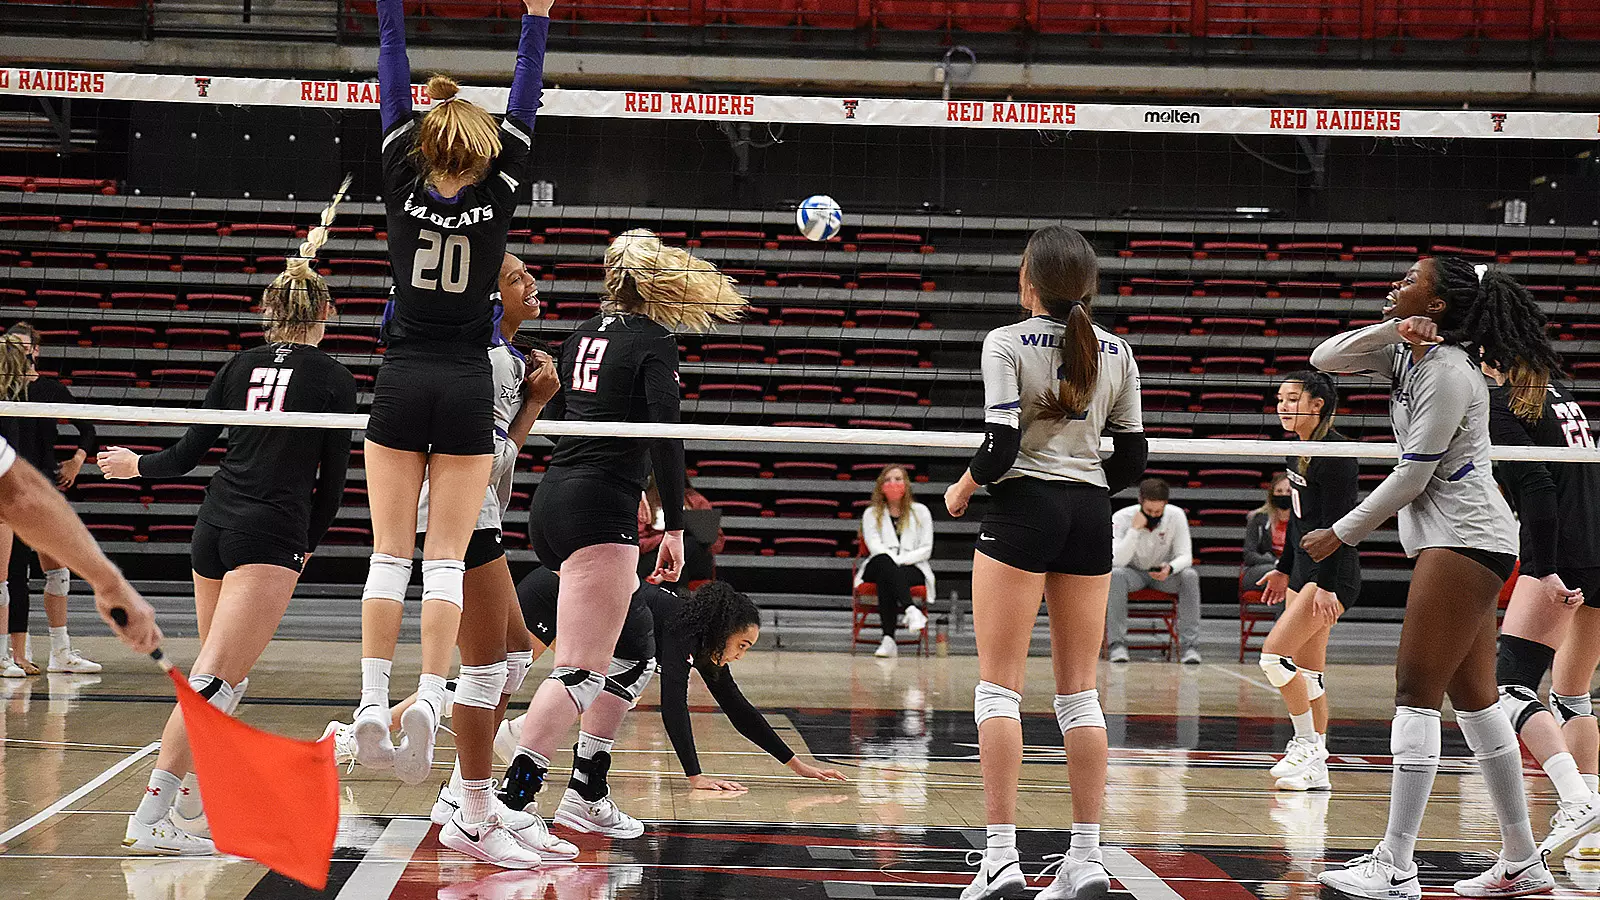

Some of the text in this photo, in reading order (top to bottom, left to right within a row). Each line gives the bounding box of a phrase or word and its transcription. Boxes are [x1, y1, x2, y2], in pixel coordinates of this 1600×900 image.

[19, 70, 105, 93] RAIDERS
[301, 81, 431, 105] RED RAIRS
[625, 92, 755, 116] RED RAIDERS
[947, 101, 1077, 125] RED RAIDERS
[1144, 109, 1201, 124] molten
[1269, 109, 1401, 131] RED RAIDERS
[411, 228, 471, 293] 20
[571, 336, 610, 393] 12
[246, 367, 294, 412] 21
[1551, 401, 1596, 448] 22
